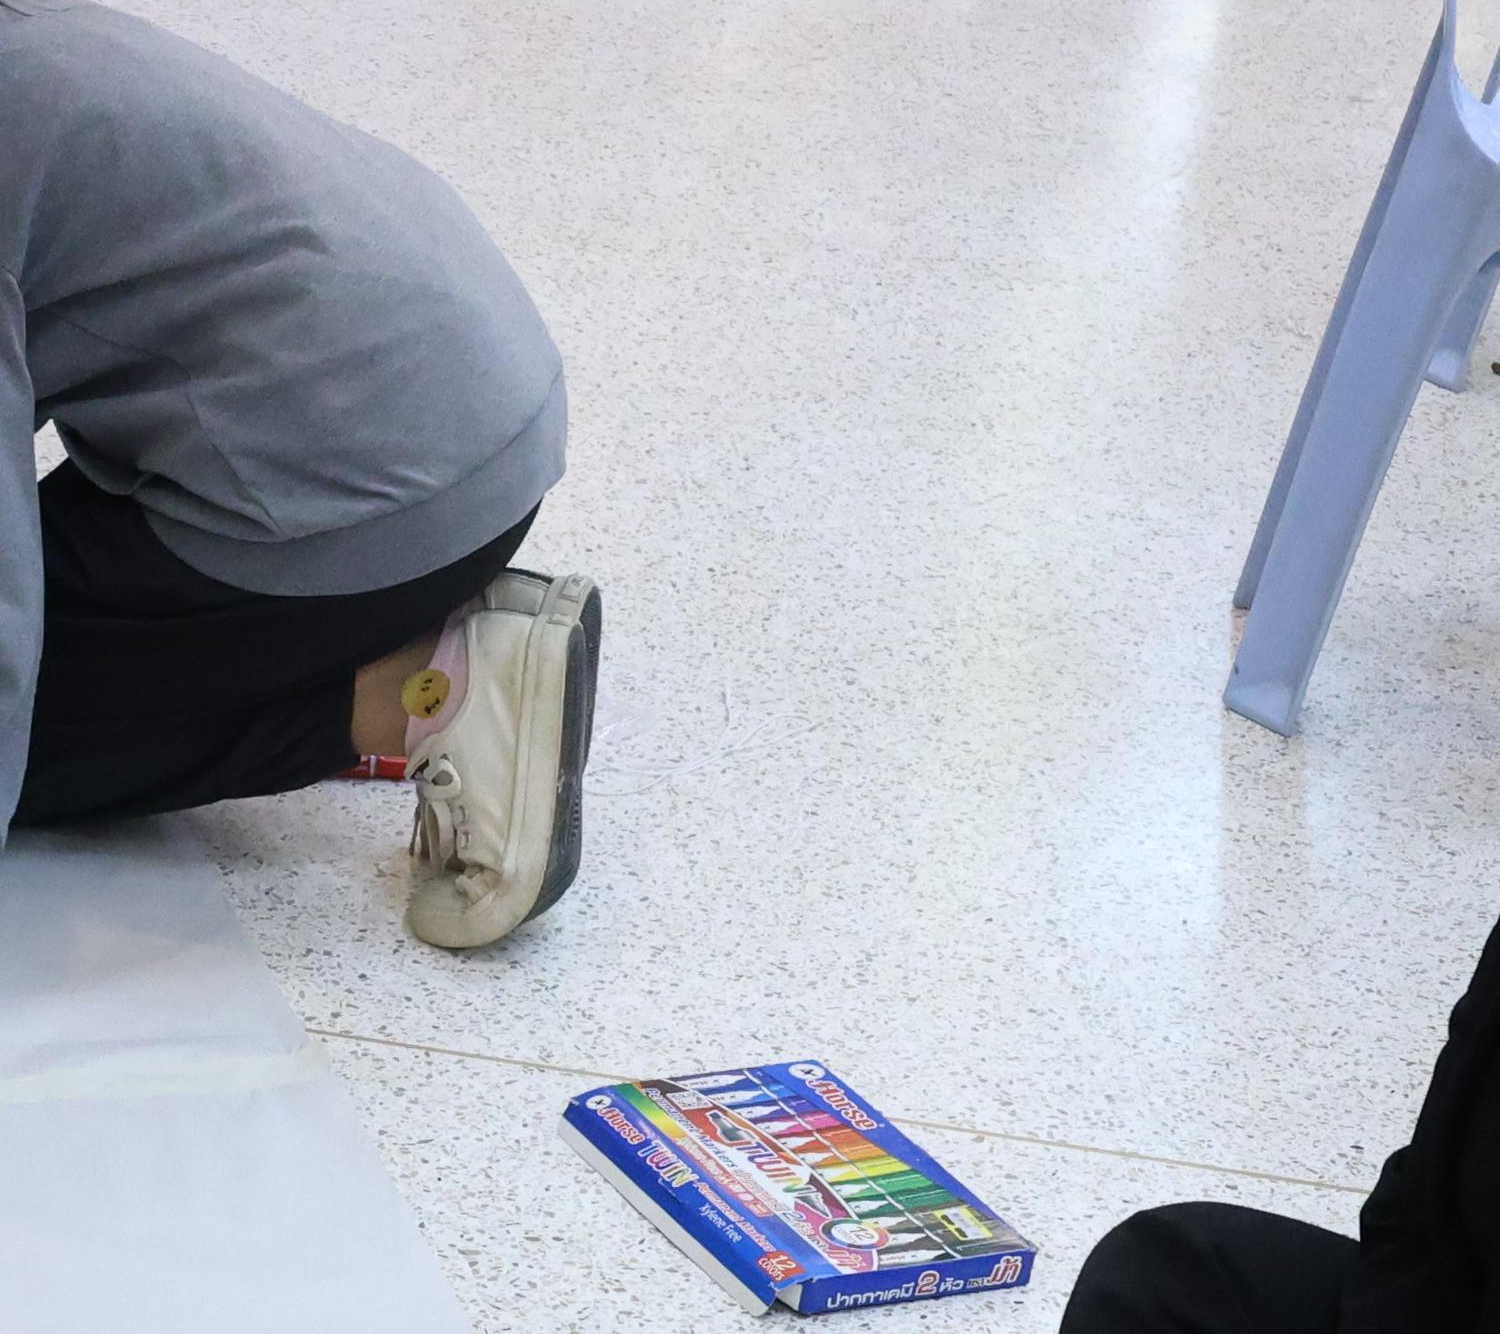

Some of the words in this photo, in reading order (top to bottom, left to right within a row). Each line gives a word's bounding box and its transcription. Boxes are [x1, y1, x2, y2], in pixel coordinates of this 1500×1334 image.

[806, 1078, 878, 1130] Horse
[597, 1105, 645, 1144] Horse
[637, 1140, 700, 1188] TWIN
[699, 1203, 727, 1229] Xylene
[722, 1223, 743, 1243] Free
[770, 1254, 797, 1271] 12
[826, 1282, 916, 1310] ปากกาเคมี
[914, 1271, 941, 1297] 2
[939, 1275, 965, 1294] หัว
